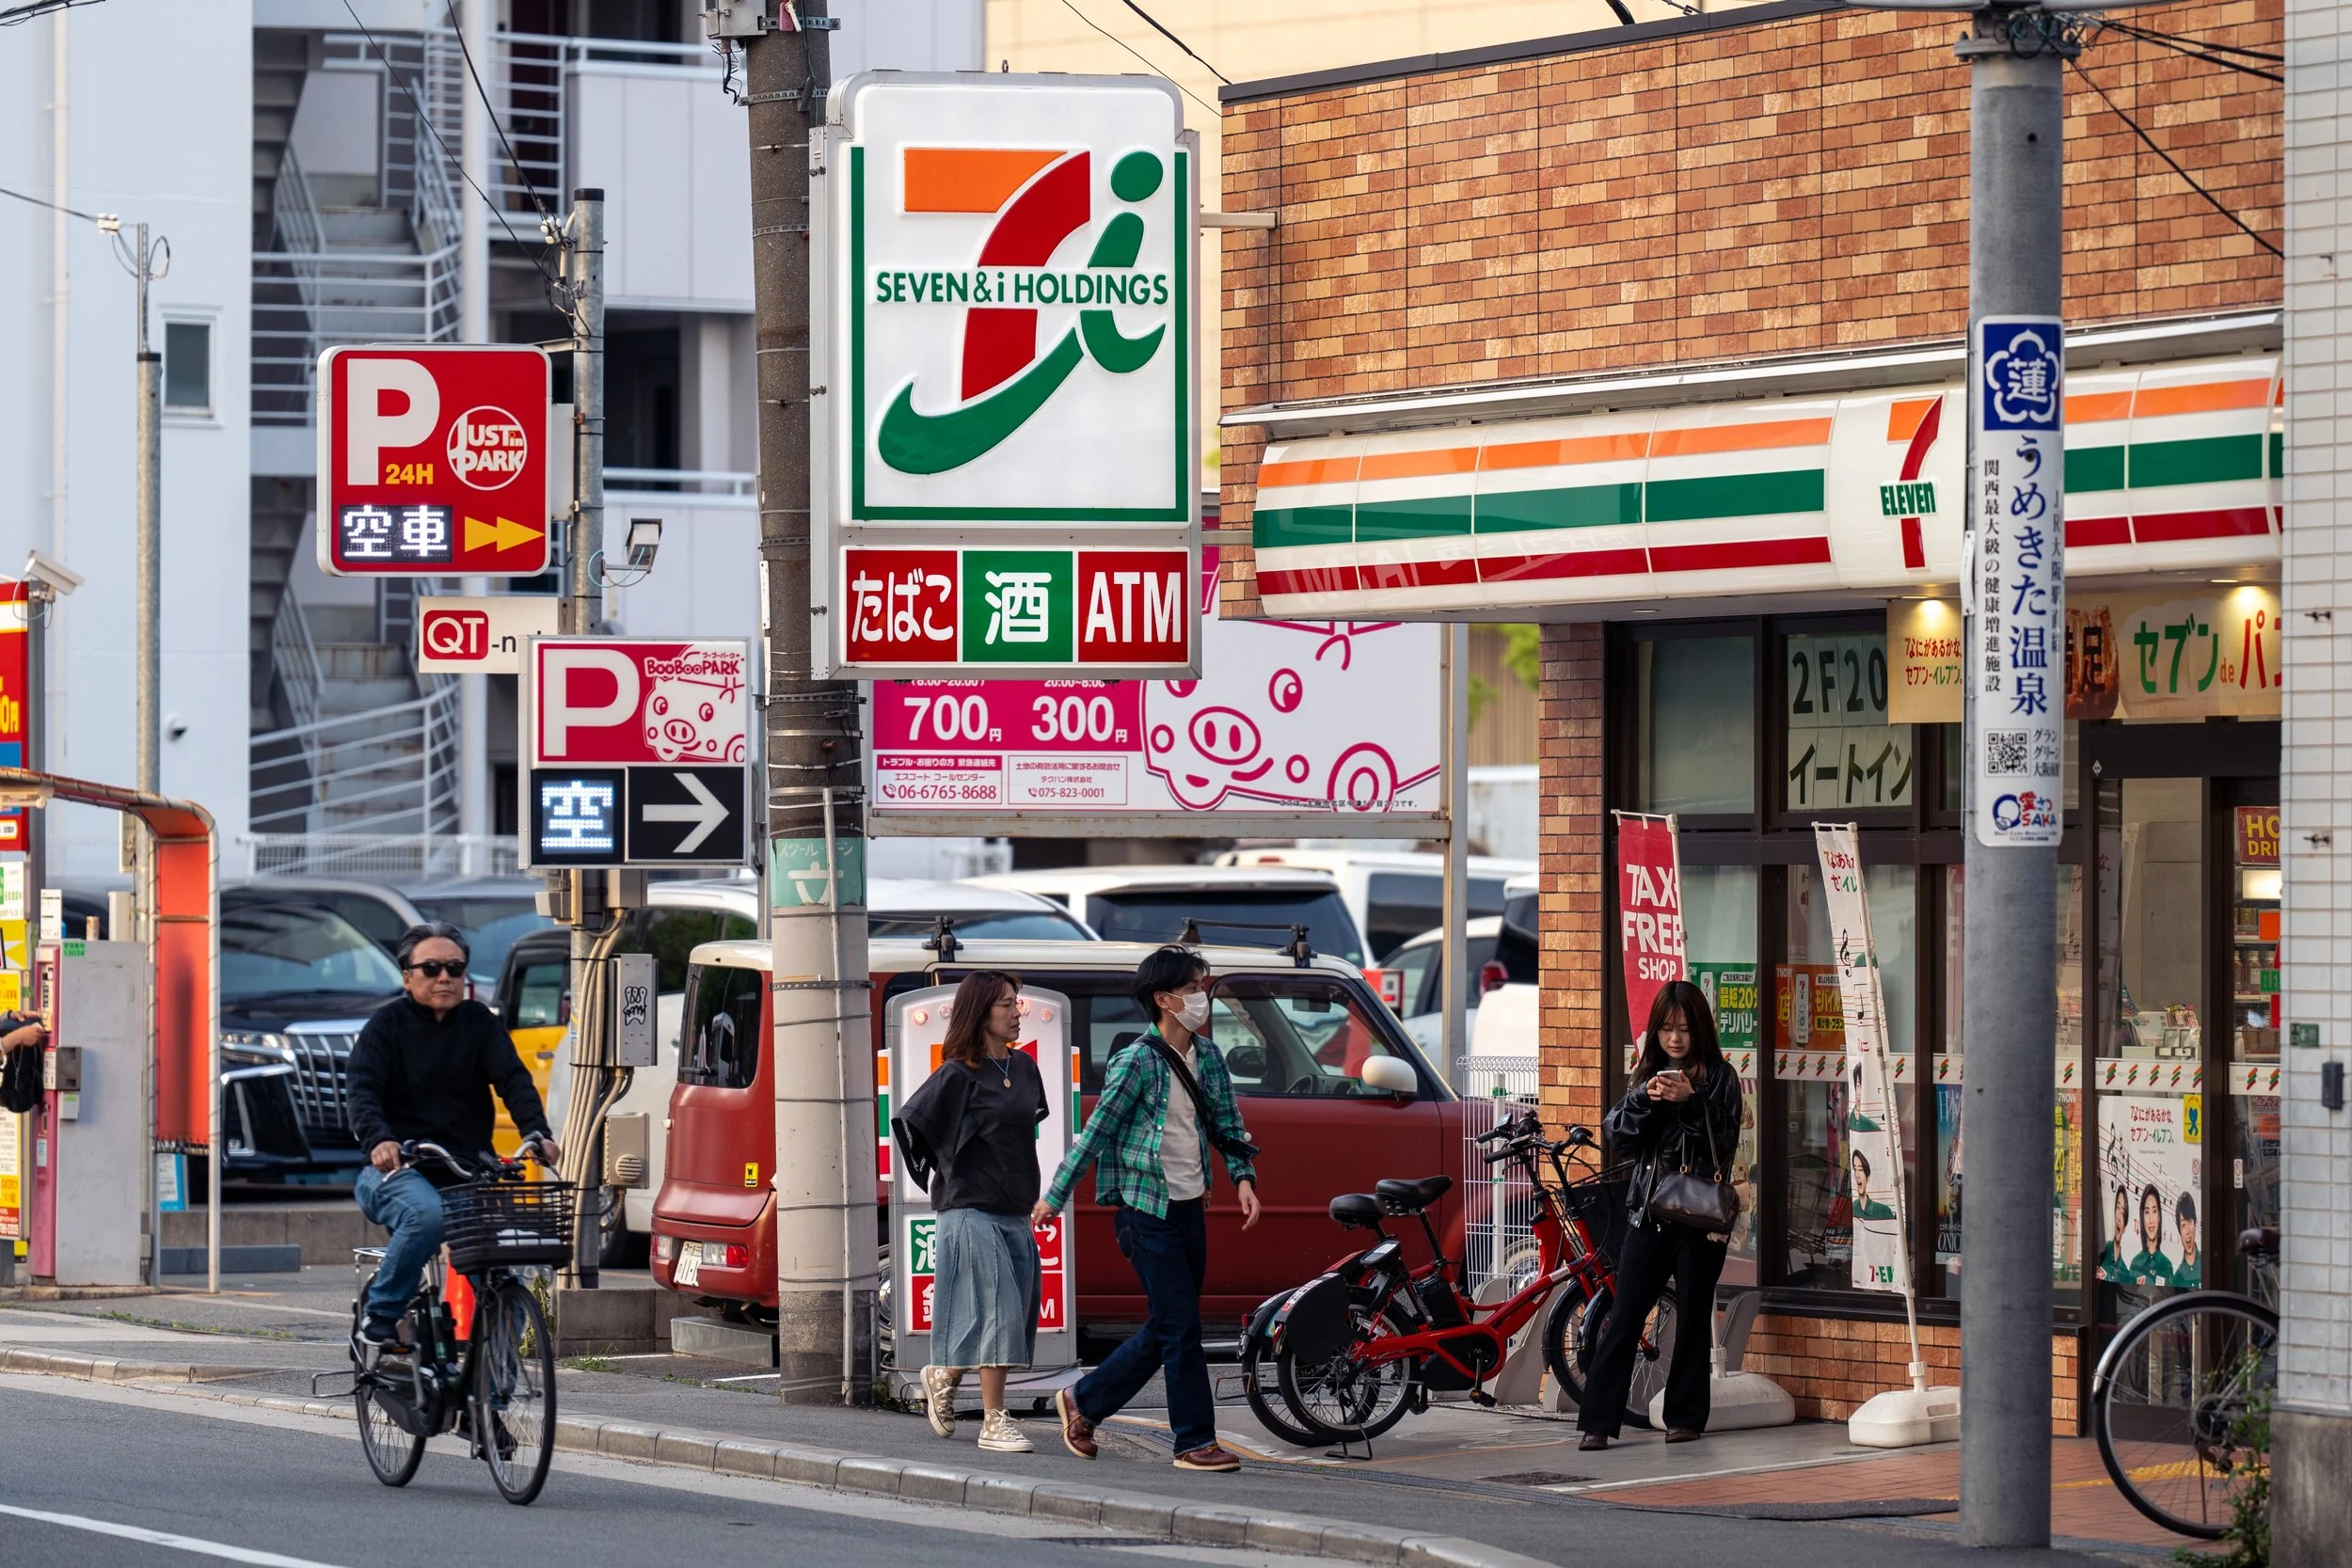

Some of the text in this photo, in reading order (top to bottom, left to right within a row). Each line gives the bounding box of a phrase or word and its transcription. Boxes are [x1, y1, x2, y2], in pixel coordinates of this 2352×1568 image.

[1014, 273, 1168, 305] HOLDINGS
[2006, 357, 2048, 403] 蓮
[347, 358, 439, 485] P
[386, 464, 434, 485] 24H
[343, 505, 448, 557] 空車
[1984, 460, 2000, 692] 関西最大級の健康増進施設
[2010, 435, 2048, 716] うめきた温泉
[851, 568, 954, 642] たばこ
[984, 570, 1052, 645] 酒
[1084, 571, 1182, 643] ATM
[427, 616, 542, 654] QT-n
[543, 649, 640, 756] P
[894, 772, 985, 782] エスコート コールセンター
[898, 784, 996, 800] 06-6765-8688
[1038, 787, 1104, 799] 075-823-0001
[1789, 741, 1912, 804] イートイン
[541, 782, 613, 847] 空
[2246, 815, 2280, 839] HO
[779, 841, 853, 858] スクール・ーン
[2248, 840, 2280, 857] DRI
[1623, 911, 1684, 957] FREE
[1638, 957, 1677, 981] SHOP
[1815, 990, 1843, 1013] モバイル
